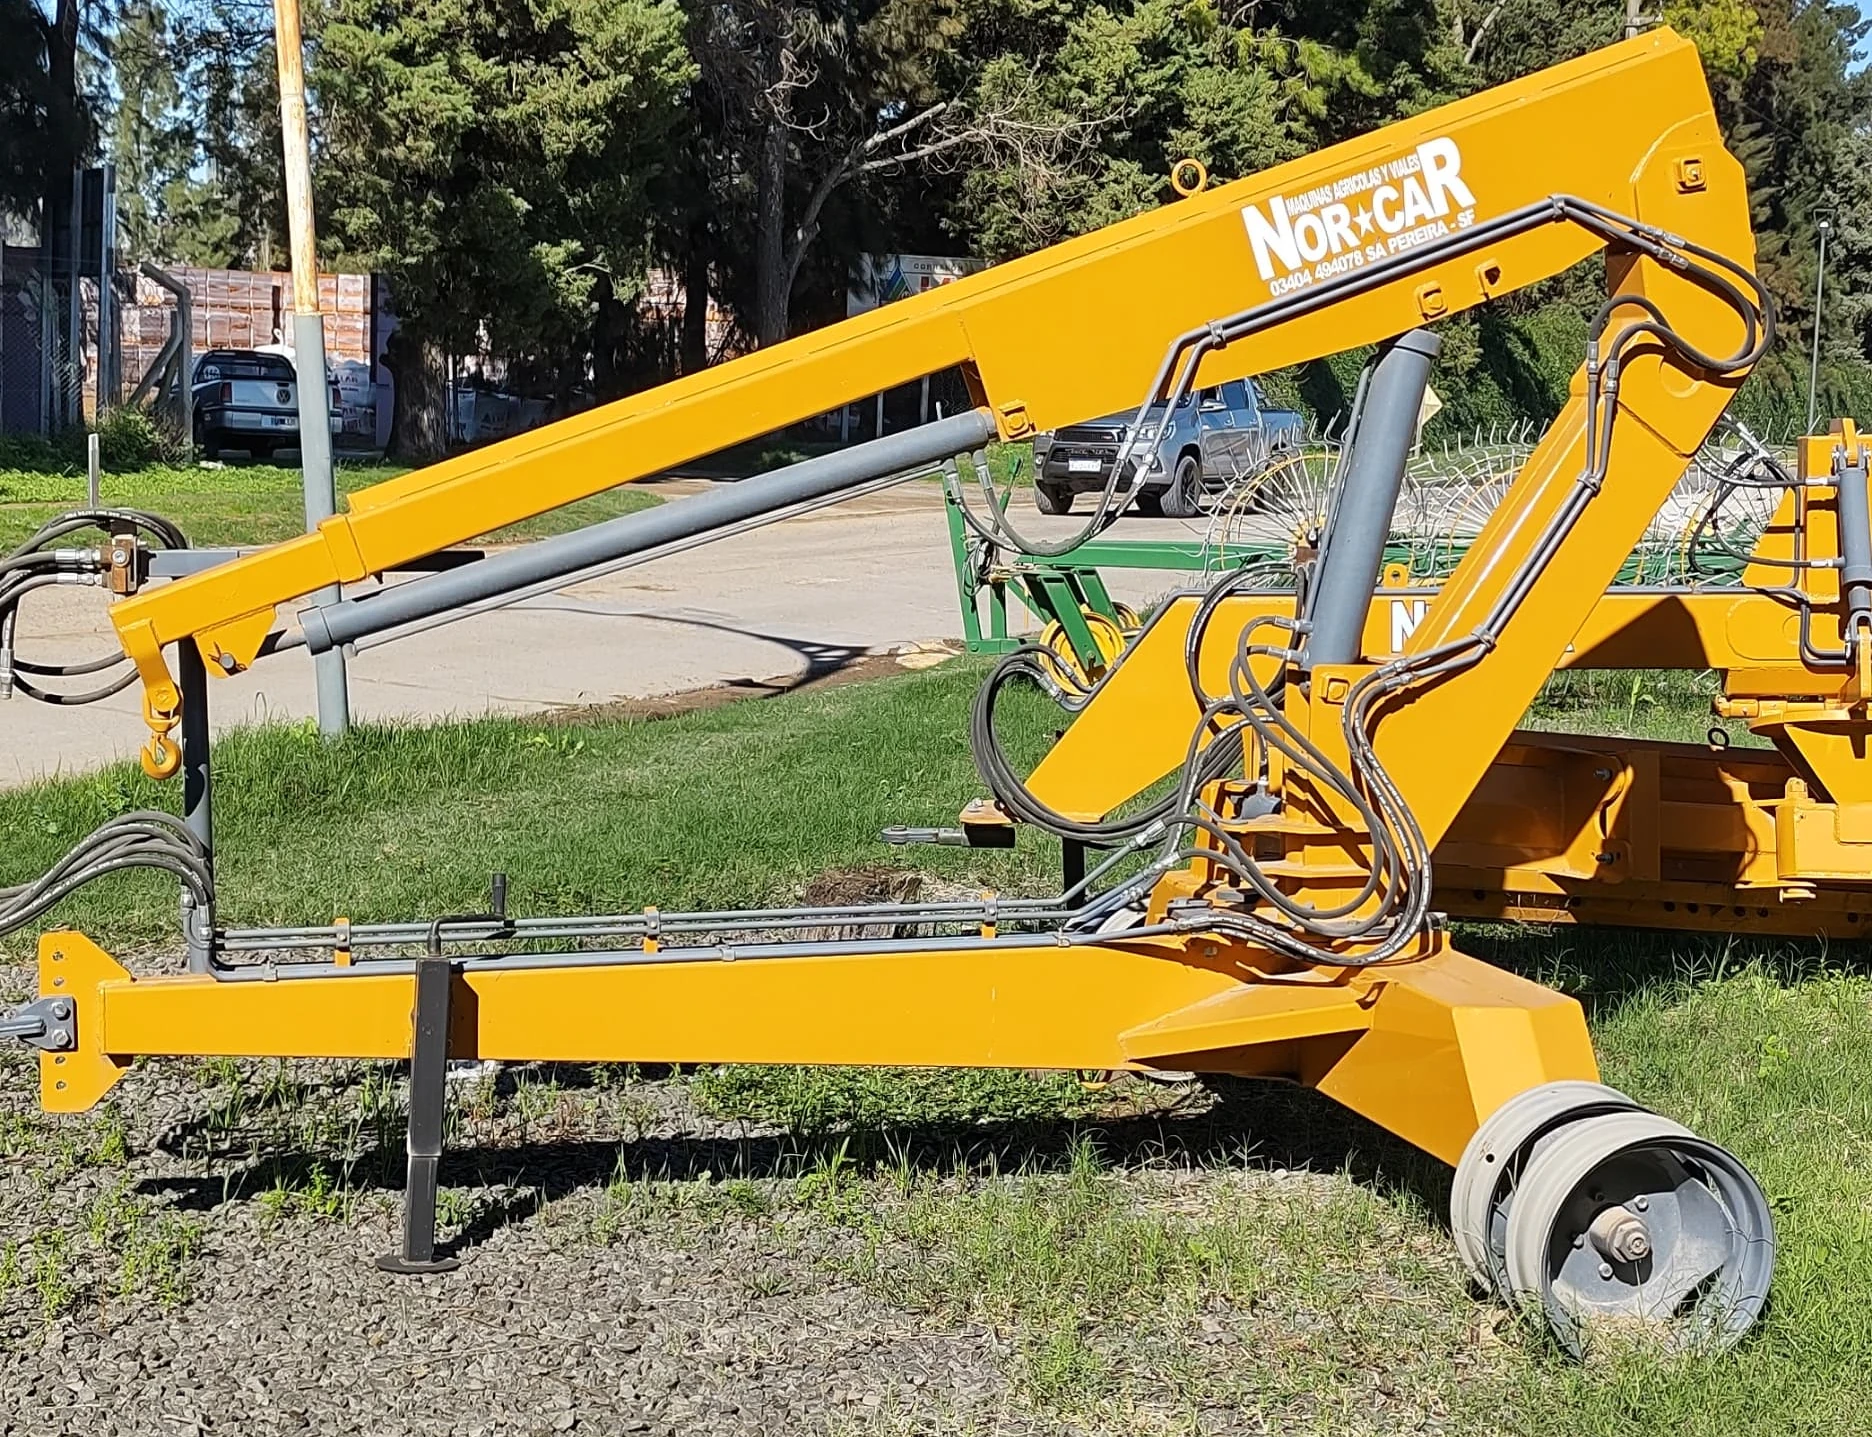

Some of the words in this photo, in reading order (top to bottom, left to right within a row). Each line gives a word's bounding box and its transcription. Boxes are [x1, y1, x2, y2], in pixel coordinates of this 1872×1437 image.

[1285, 185, 1333, 216] MAQUINAS
[1333, 167, 1382, 199] AGRICOLAS
[1380, 165, 1390, 183] Y
[1388, 154, 1421, 179] VIALES
[1269, 269, 1313, 296] 03404
[1315, 250, 1364, 280] 494078
[1387, 220, 1449, 253] PEREIRA
[1457, 208, 1475, 229] SF
